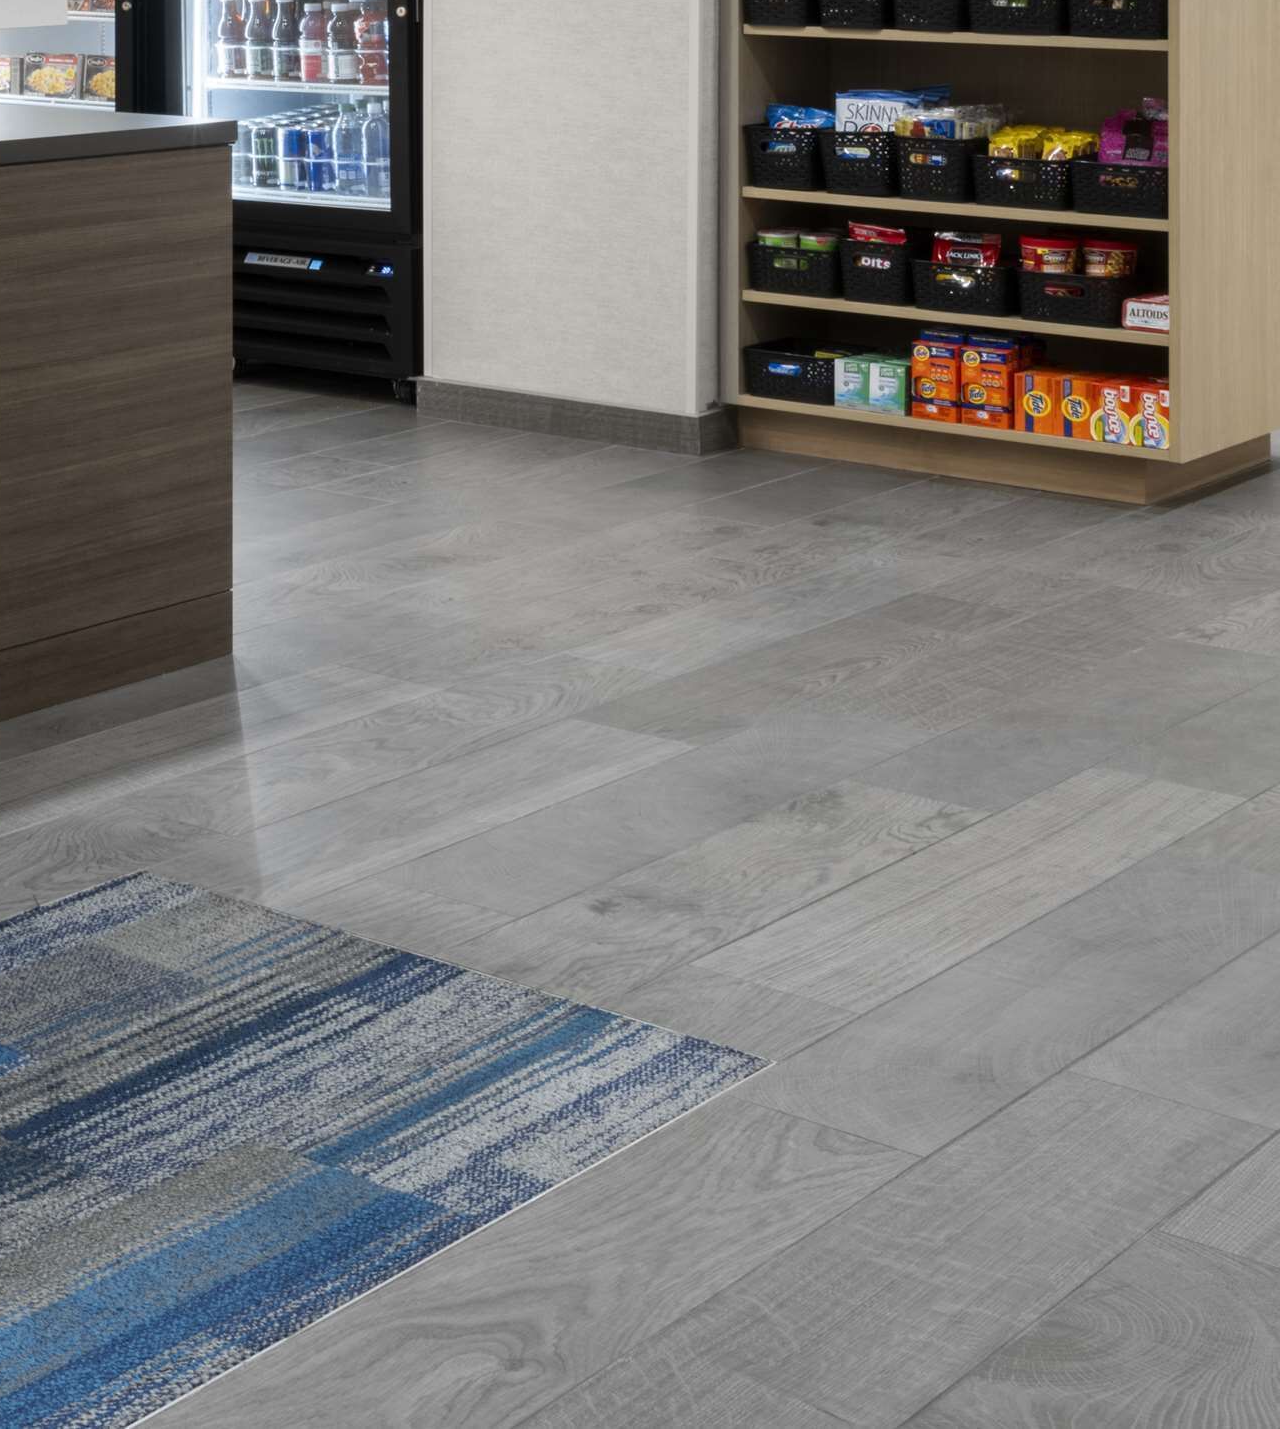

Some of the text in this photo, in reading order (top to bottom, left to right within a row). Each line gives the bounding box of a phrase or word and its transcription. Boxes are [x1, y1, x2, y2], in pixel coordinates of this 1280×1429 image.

[1129, 306, 1169, 320] ALTOIDS
[1029, 393, 1045, 414] Tide
[1102, 388, 1121, 435] bounce
